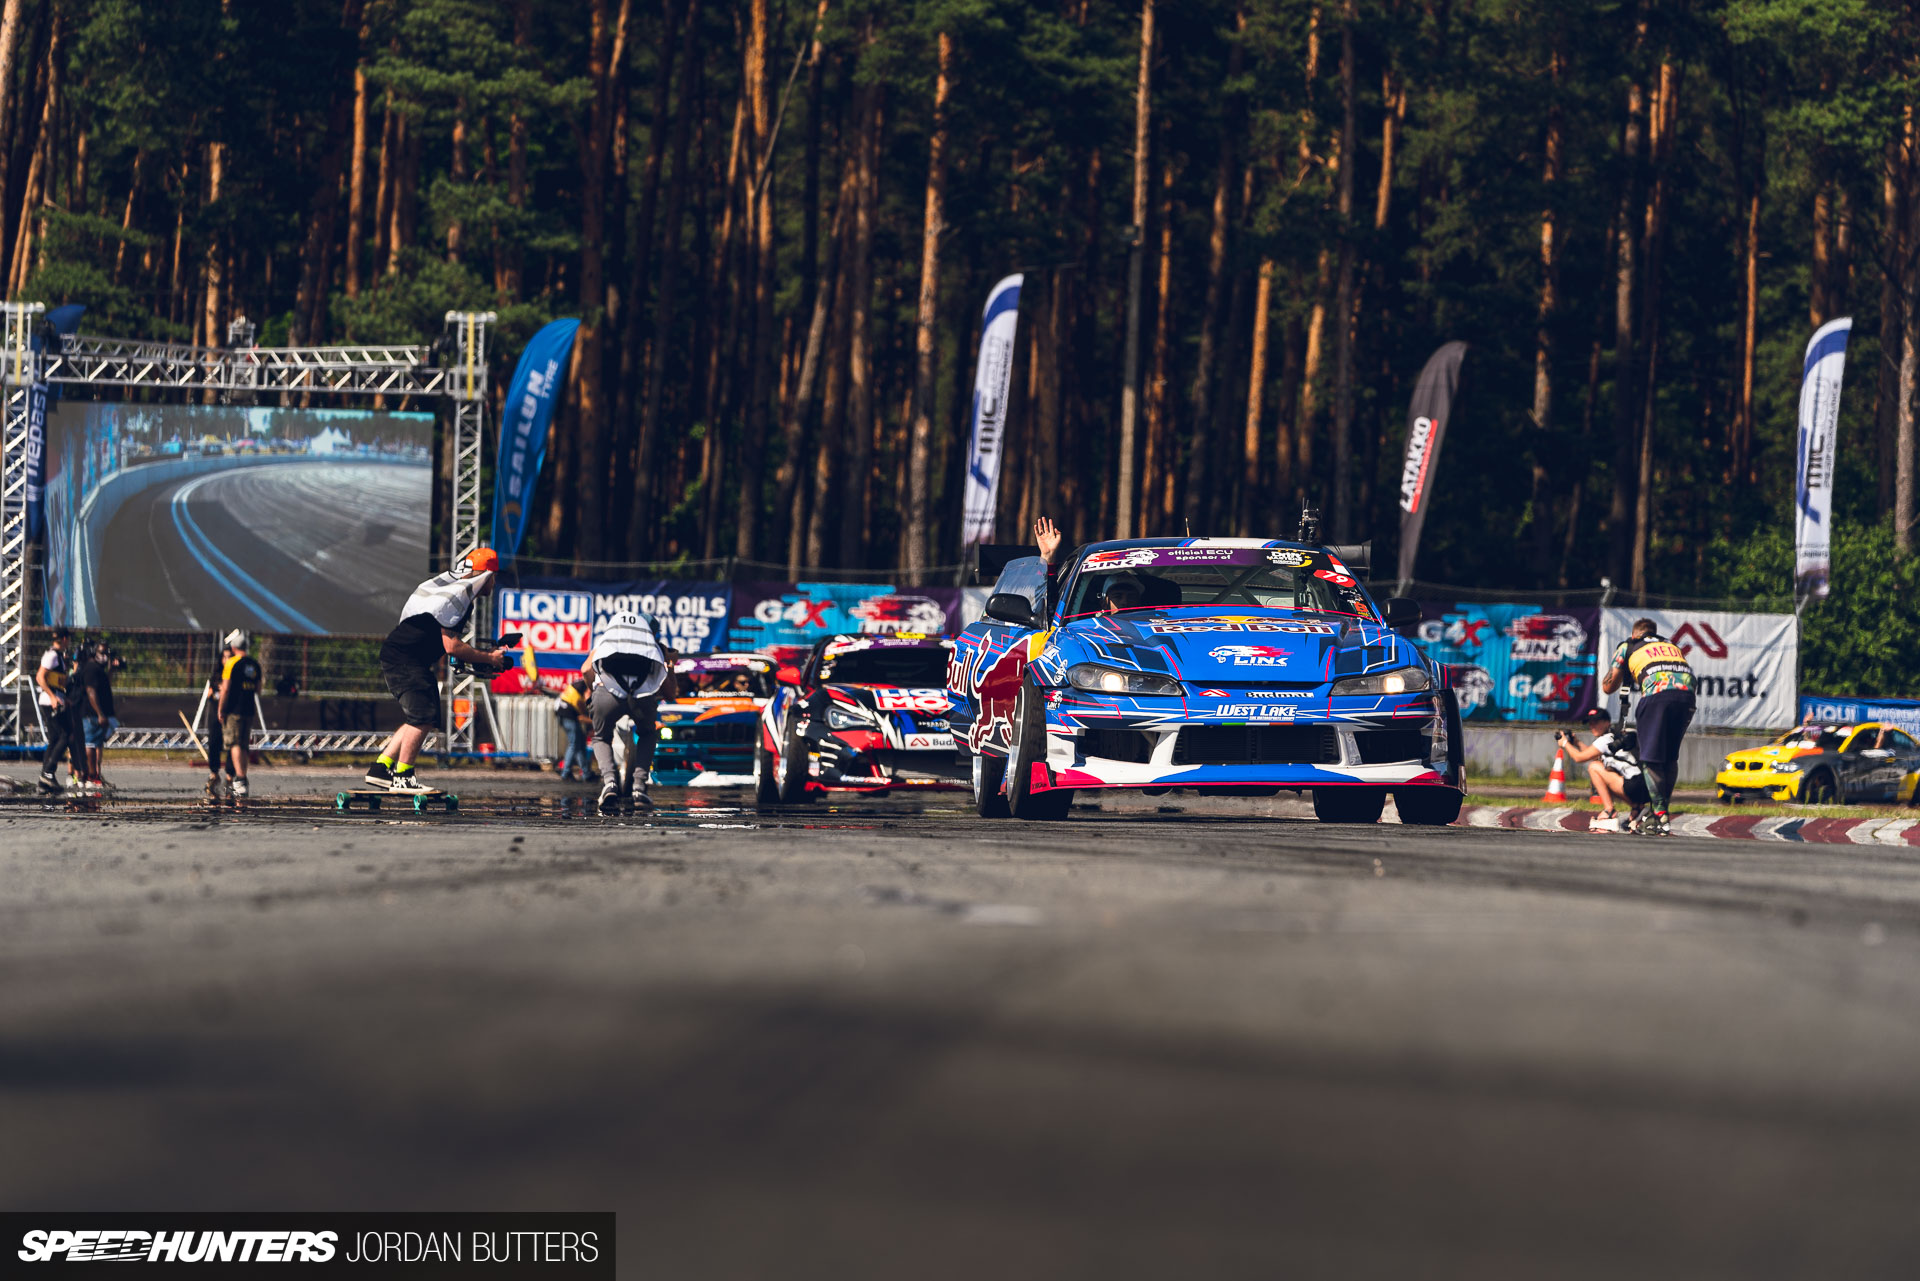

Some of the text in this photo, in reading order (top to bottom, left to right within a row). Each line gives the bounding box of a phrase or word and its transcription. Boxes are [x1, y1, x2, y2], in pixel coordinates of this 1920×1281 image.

[541, 359, 558, 399] TYRE
[509, 369, 544, 498] SAILUN
[1400, 416, 1432, 513] LATAKKO
[1083, 560, 1134, 571] LINK
[1322, 570, 1349, 583] 79
[505, 593, 588, 622] LIQUI
[595, 593, 726, 618] MOTOR OILS
[754, 600, 831, 627] G4X
[621, 616, 636, 624] 10
[1152, 624, 1335, 635] Red Bull
[1418, 619, 1489, 647] G4X
[504, 622, 589, 650] MOLY
[1511, 640, 1561, 655] LINK
[947, 643, 975, 697] Bull
[1234, 656, 1289, 665] LINK
[1509, 673, 1577, 702] G4X
[1216, 704, 1298, 717] WEST LAKE
